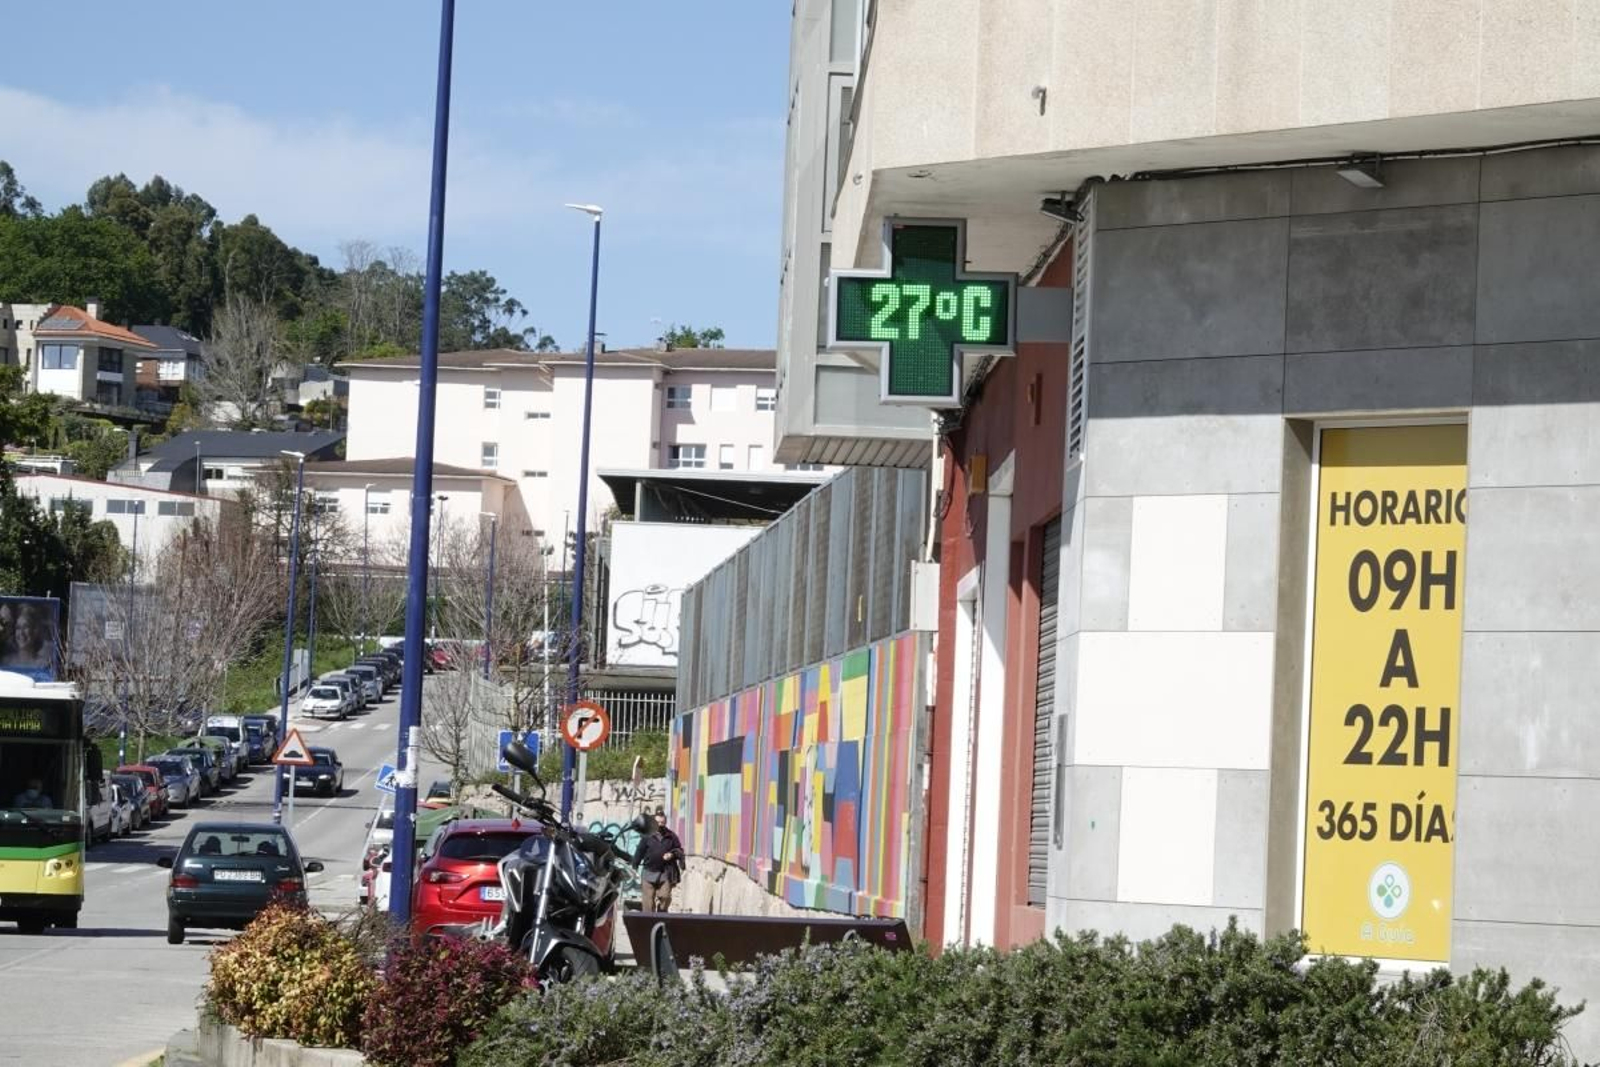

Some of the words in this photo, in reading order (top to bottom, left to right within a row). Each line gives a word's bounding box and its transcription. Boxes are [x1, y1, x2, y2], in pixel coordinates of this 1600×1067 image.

[1348, 549, 1457, 612] 09H
[1379, 628, 1419, 688] A
[1342, 704, 1451, 767] 22H
[1316, 799, 1378, 841] 365
[1390, 790, 1455, 843] DÍA
